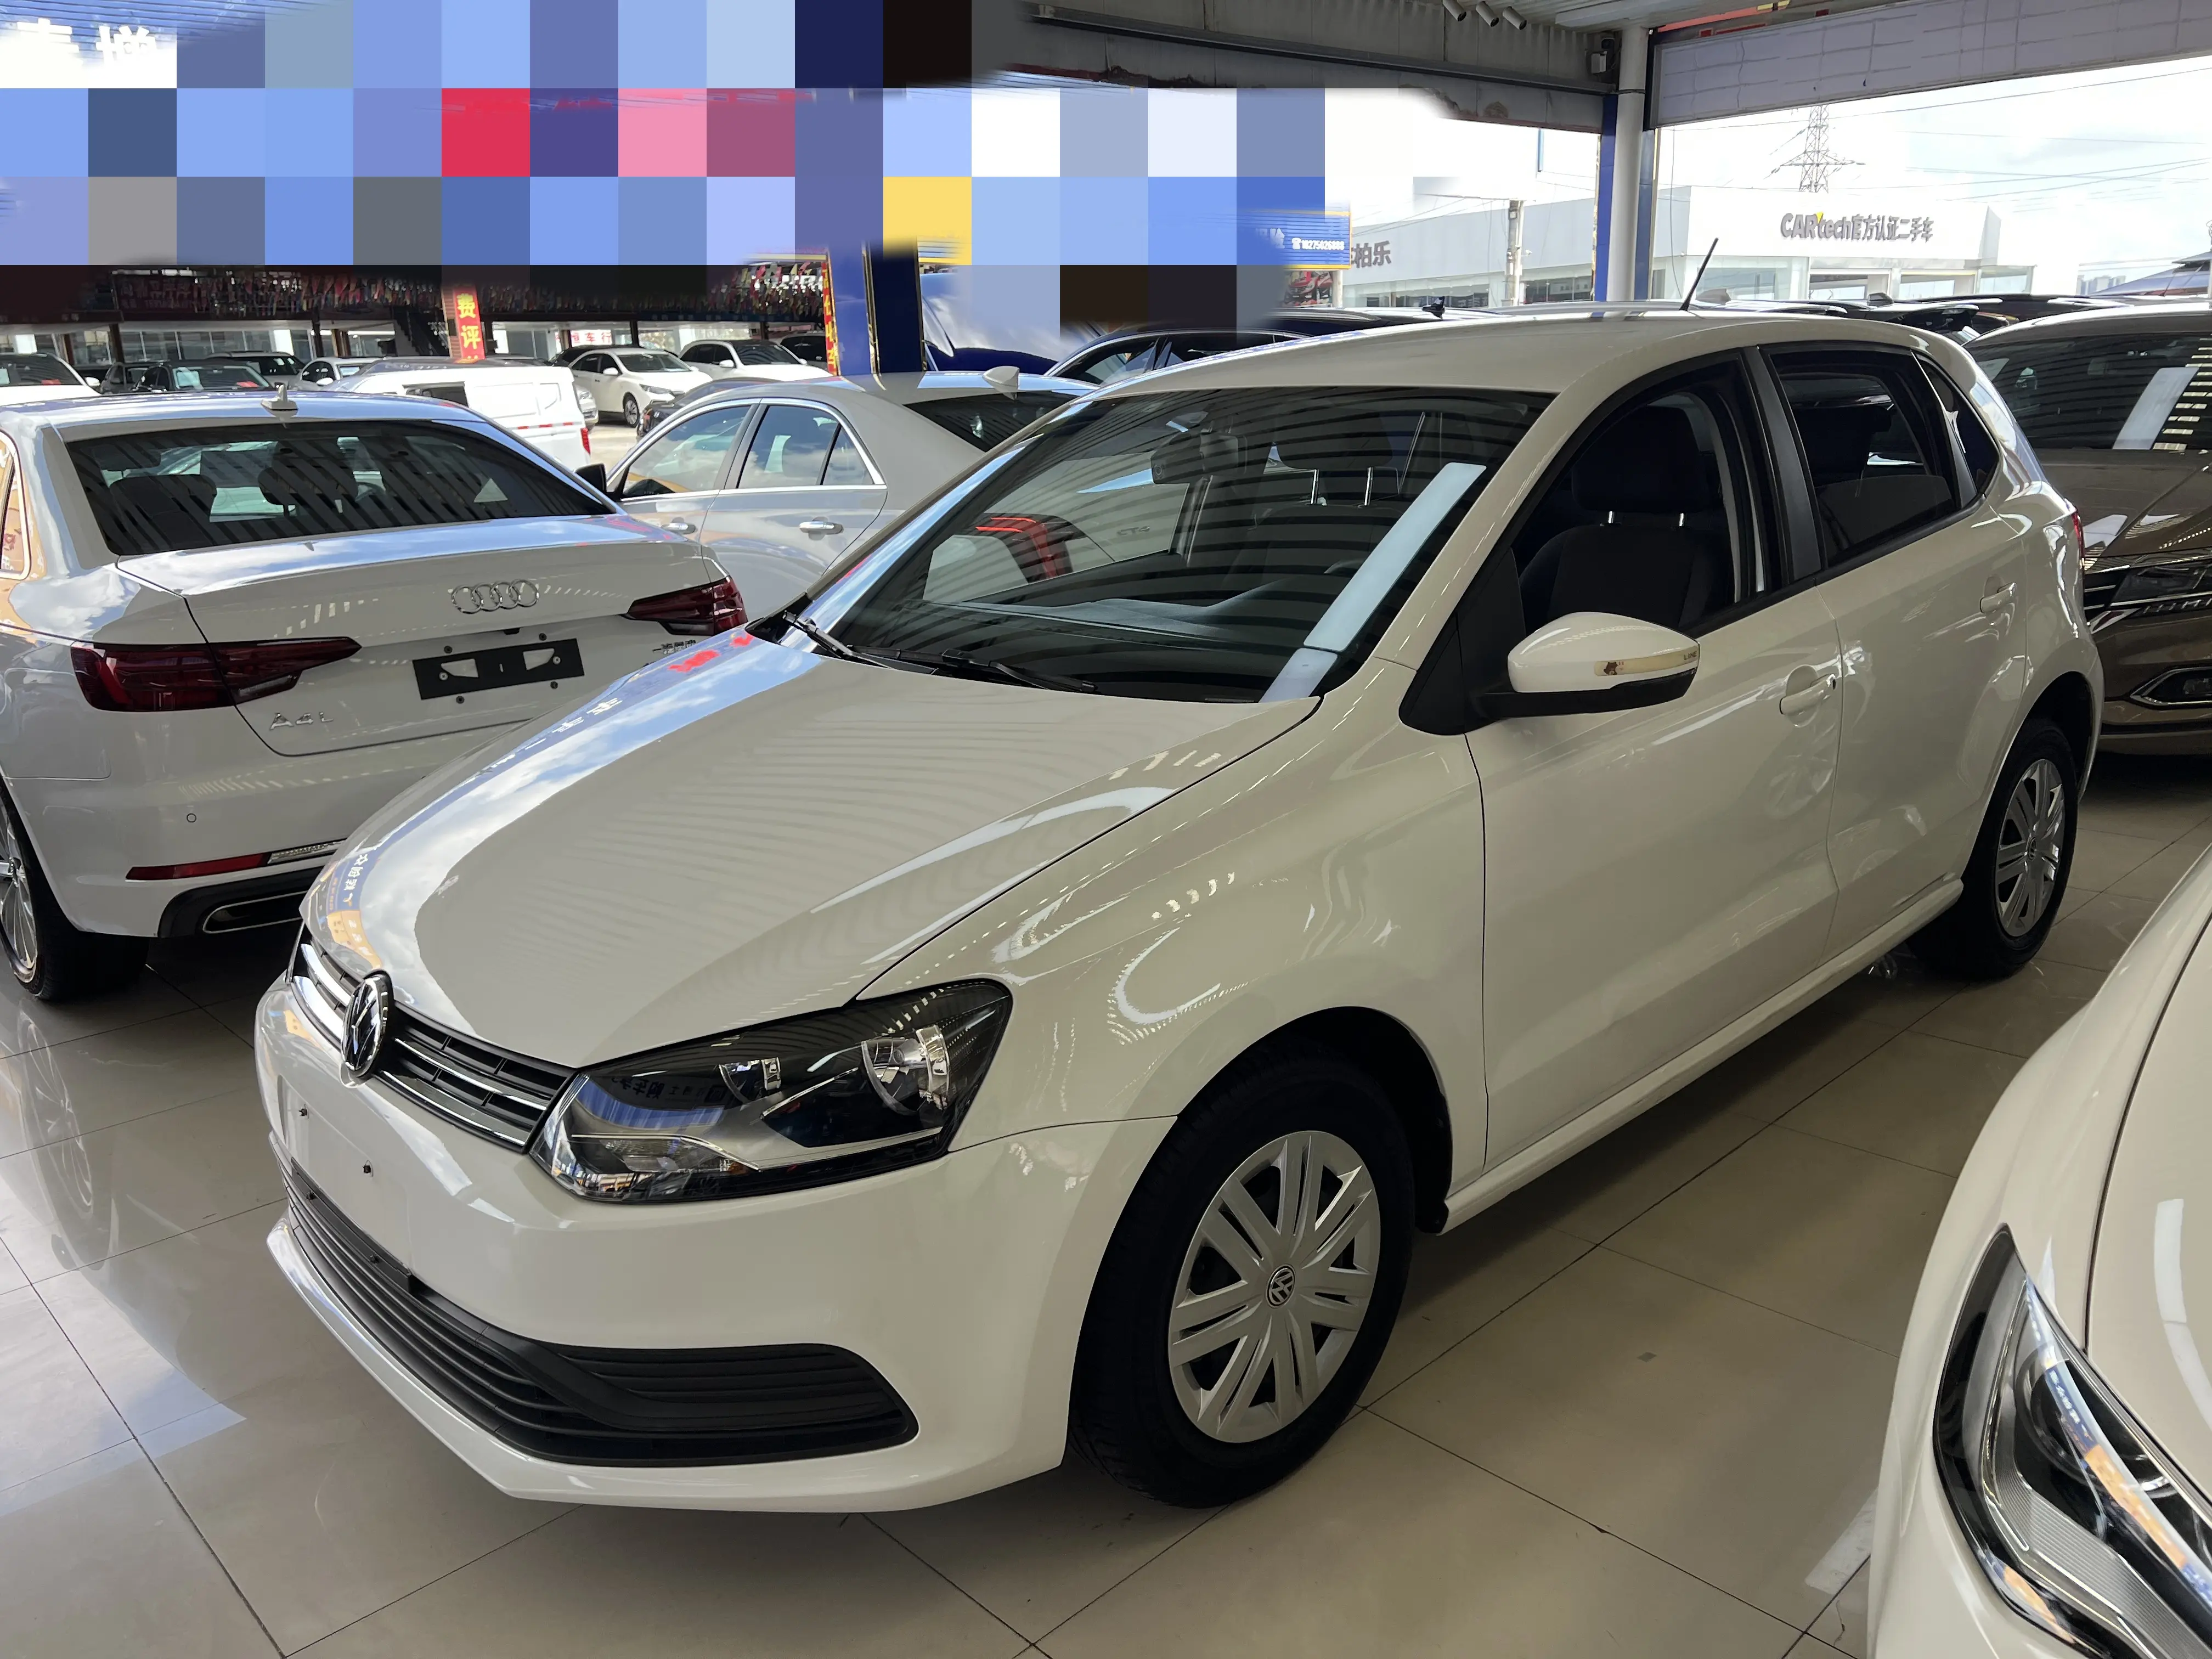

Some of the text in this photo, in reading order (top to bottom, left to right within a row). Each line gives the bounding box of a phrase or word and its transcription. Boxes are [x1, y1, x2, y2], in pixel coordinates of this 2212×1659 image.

[456, 293, 481, 360] 费评
[1684, 651, 1697, 661] LINE
[269, 712, 334, 731] A4L
